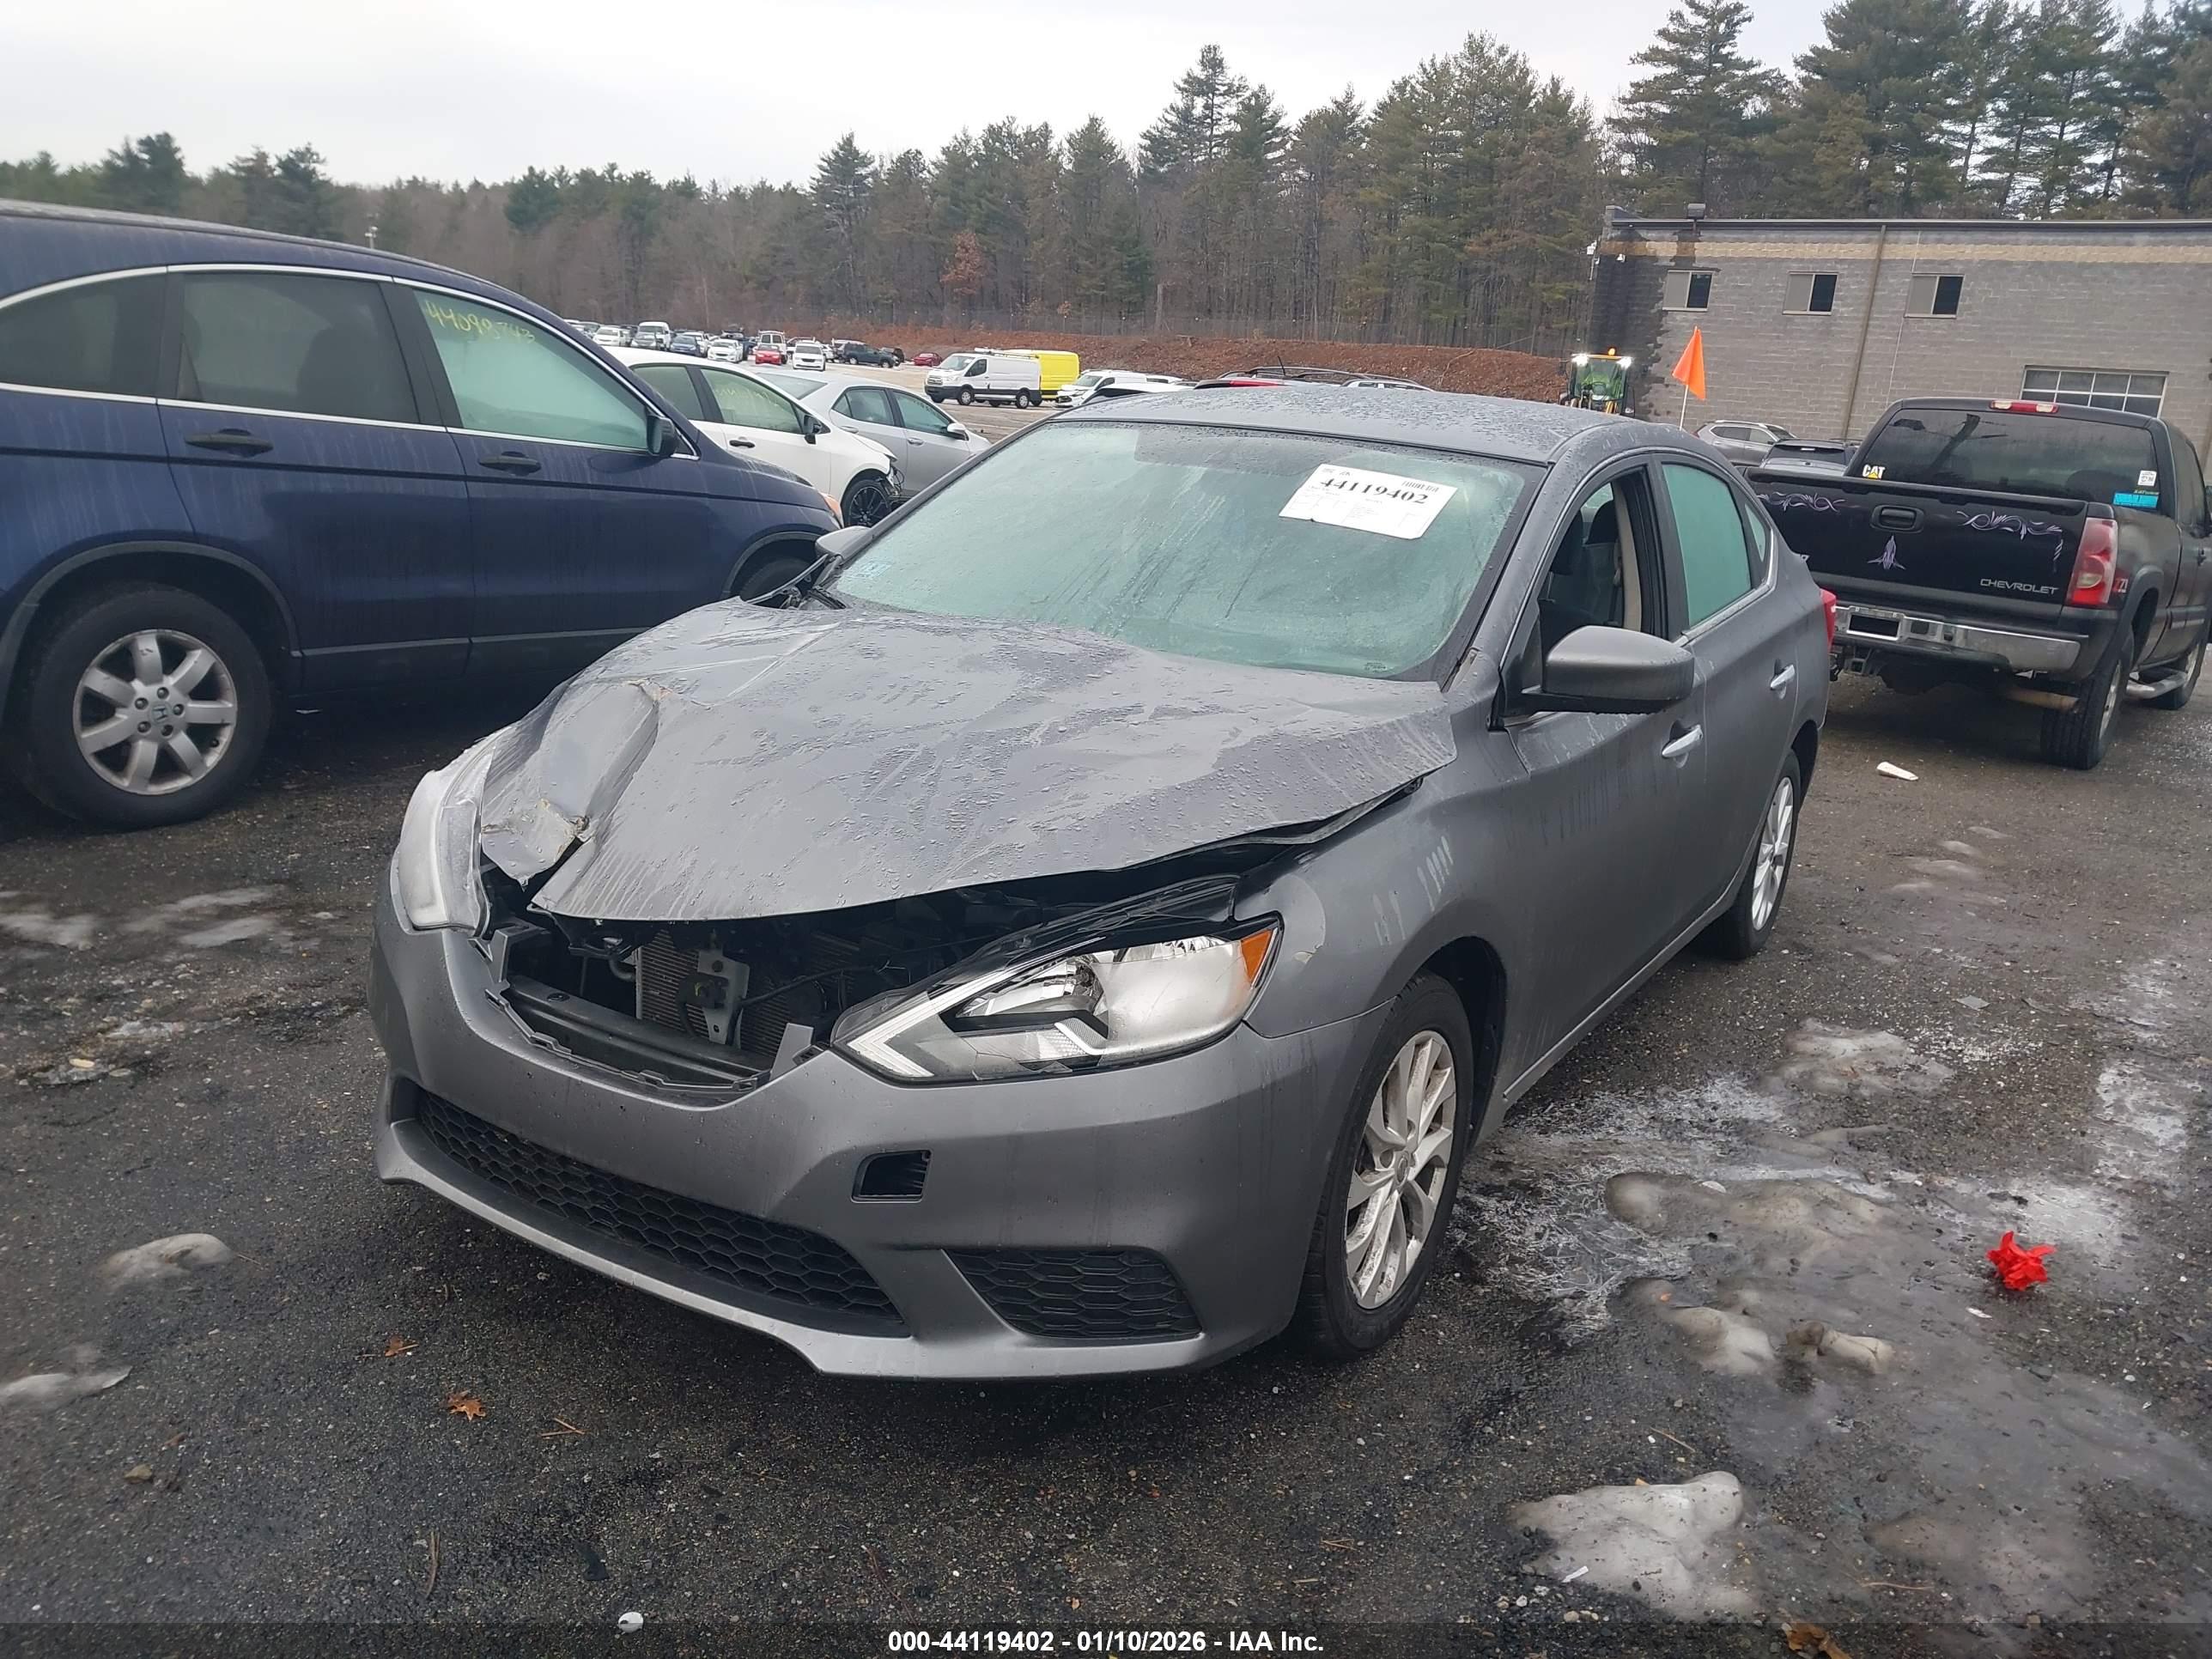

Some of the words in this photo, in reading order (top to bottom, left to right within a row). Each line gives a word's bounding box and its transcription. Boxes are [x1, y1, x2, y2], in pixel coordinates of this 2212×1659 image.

[1862, 464, 1886, 479] CAT
[1320, 477, 1429, 505] 44119402
[1979, 578, 2060, 595] CHEVROLET
